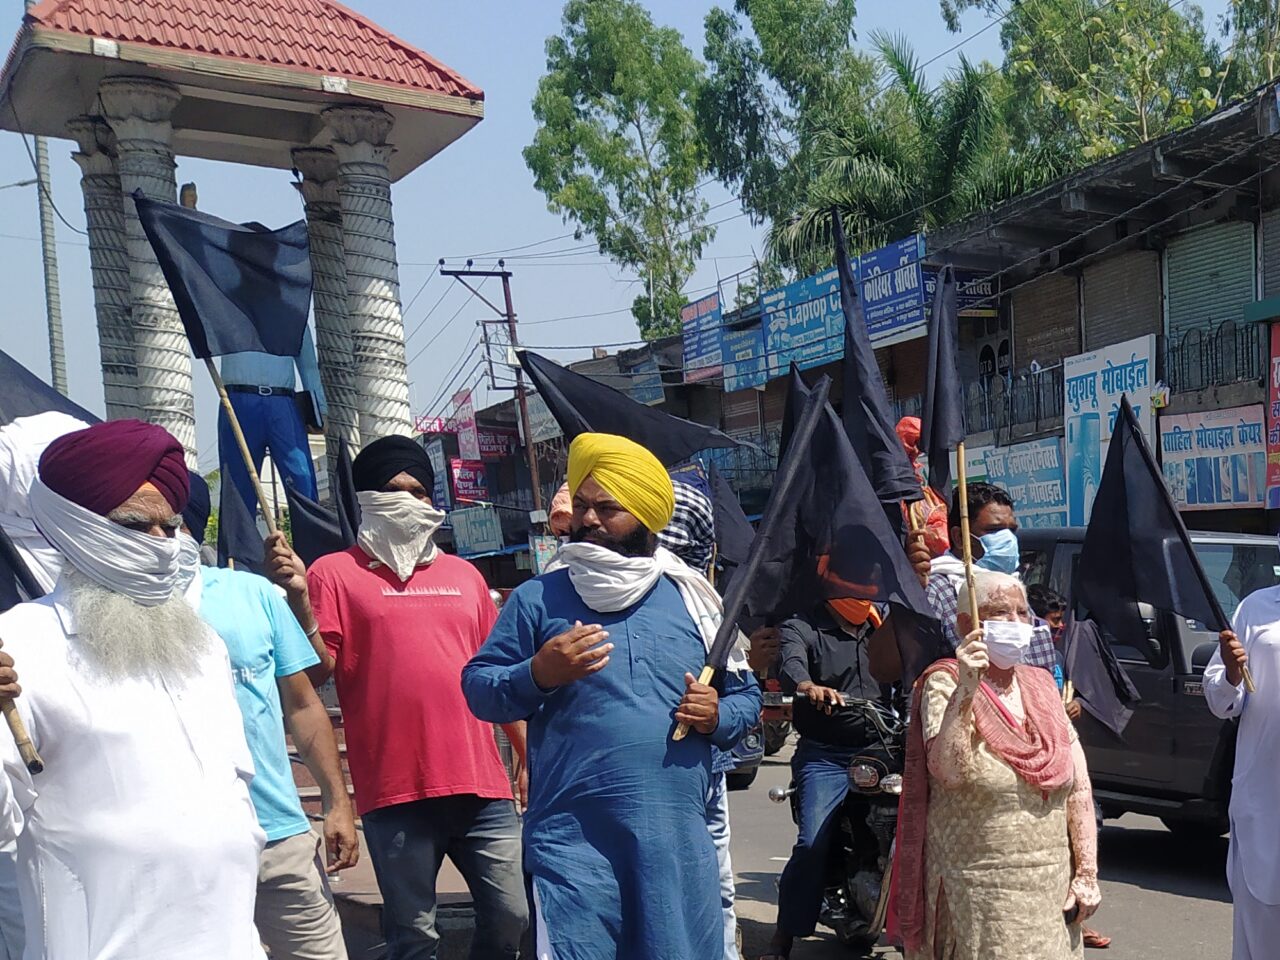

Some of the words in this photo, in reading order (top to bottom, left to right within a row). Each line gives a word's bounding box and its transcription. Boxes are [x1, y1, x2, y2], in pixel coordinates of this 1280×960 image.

[789, 294, 827, 329] Laptop
[1066, 371, 1099, 412] खुशबू
[1101, 352, 1149, 394] मोबाईल
[1162, 425, 1193, 452] साहिल
[1195, 423, 1234, 451] मोबाइल
[1237, 418, 1262, 445] केयर
[1268, 422, 1280, 445] की
